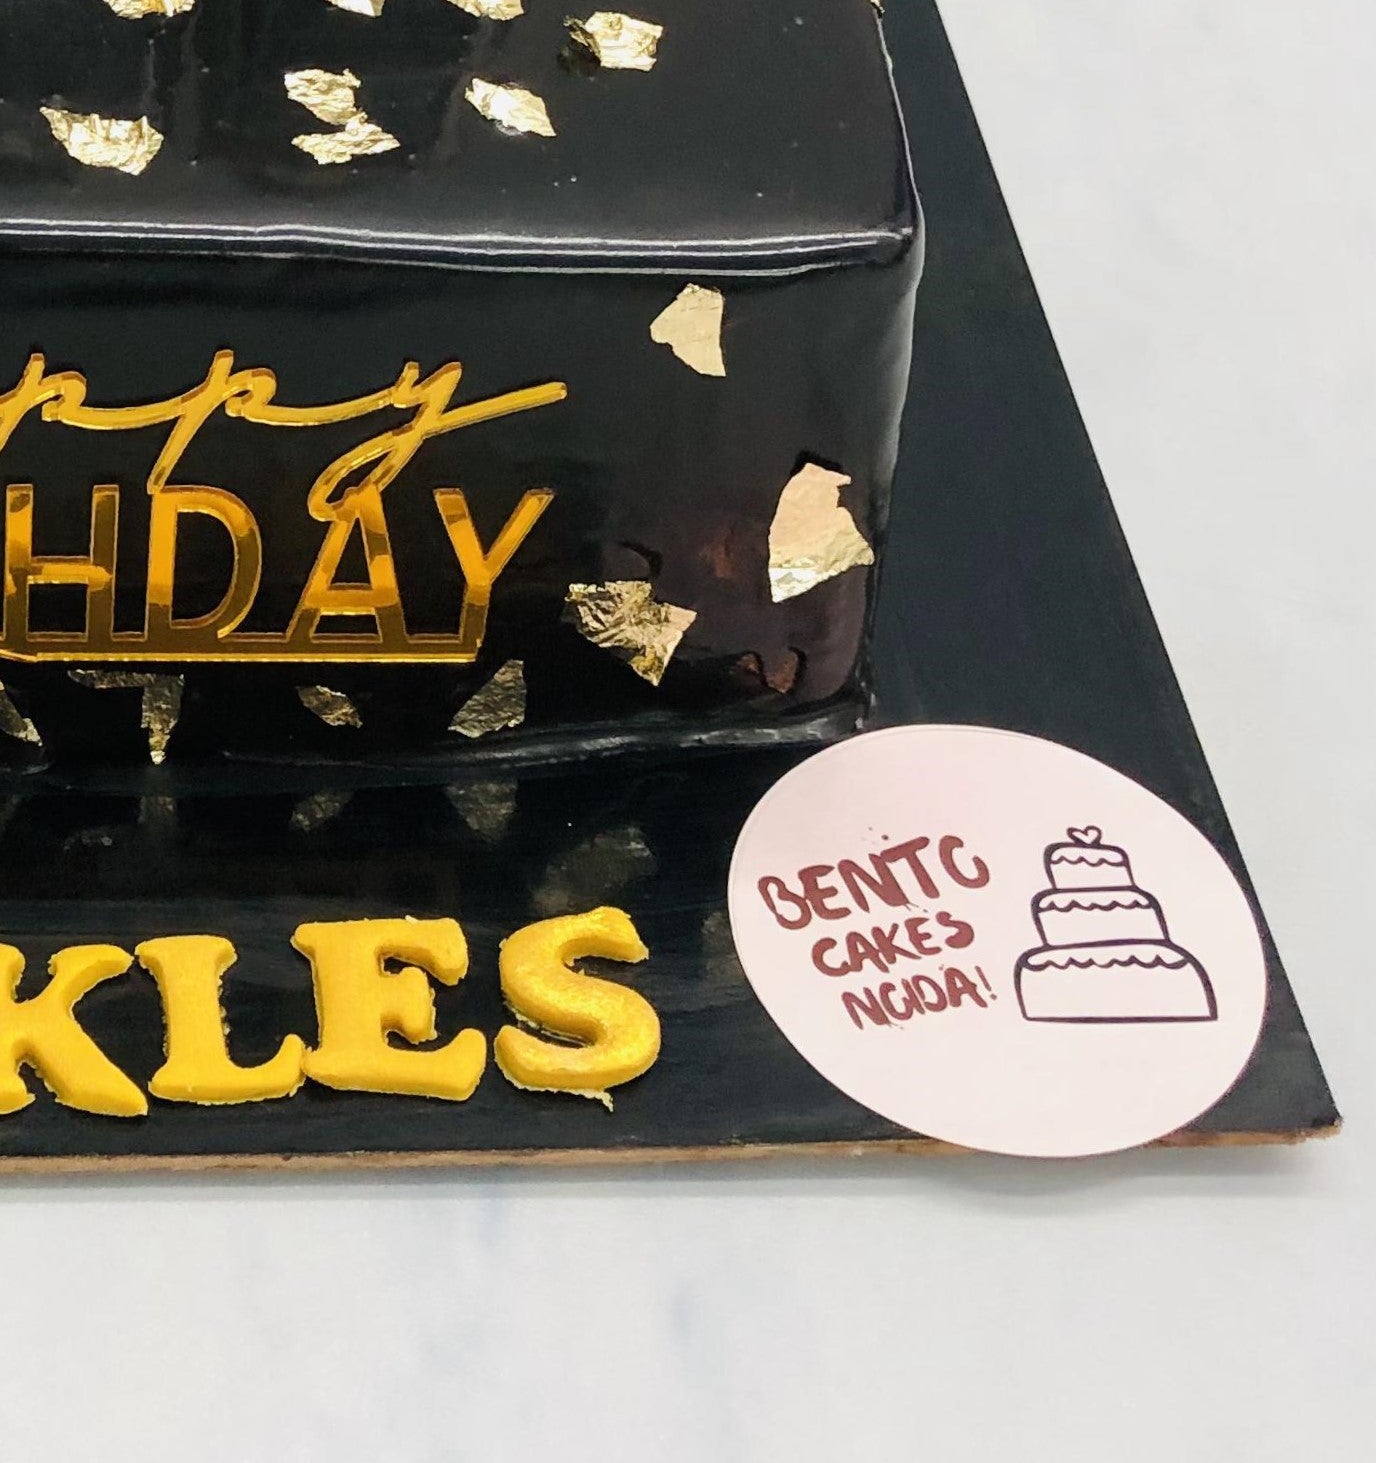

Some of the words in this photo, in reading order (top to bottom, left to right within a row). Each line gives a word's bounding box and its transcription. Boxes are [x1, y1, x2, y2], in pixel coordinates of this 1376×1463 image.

[757, 835, 990, 930] BENTO
[811, 910, 975, 977] CAKES
[841, 965, 998, 1030] NOIDA!
